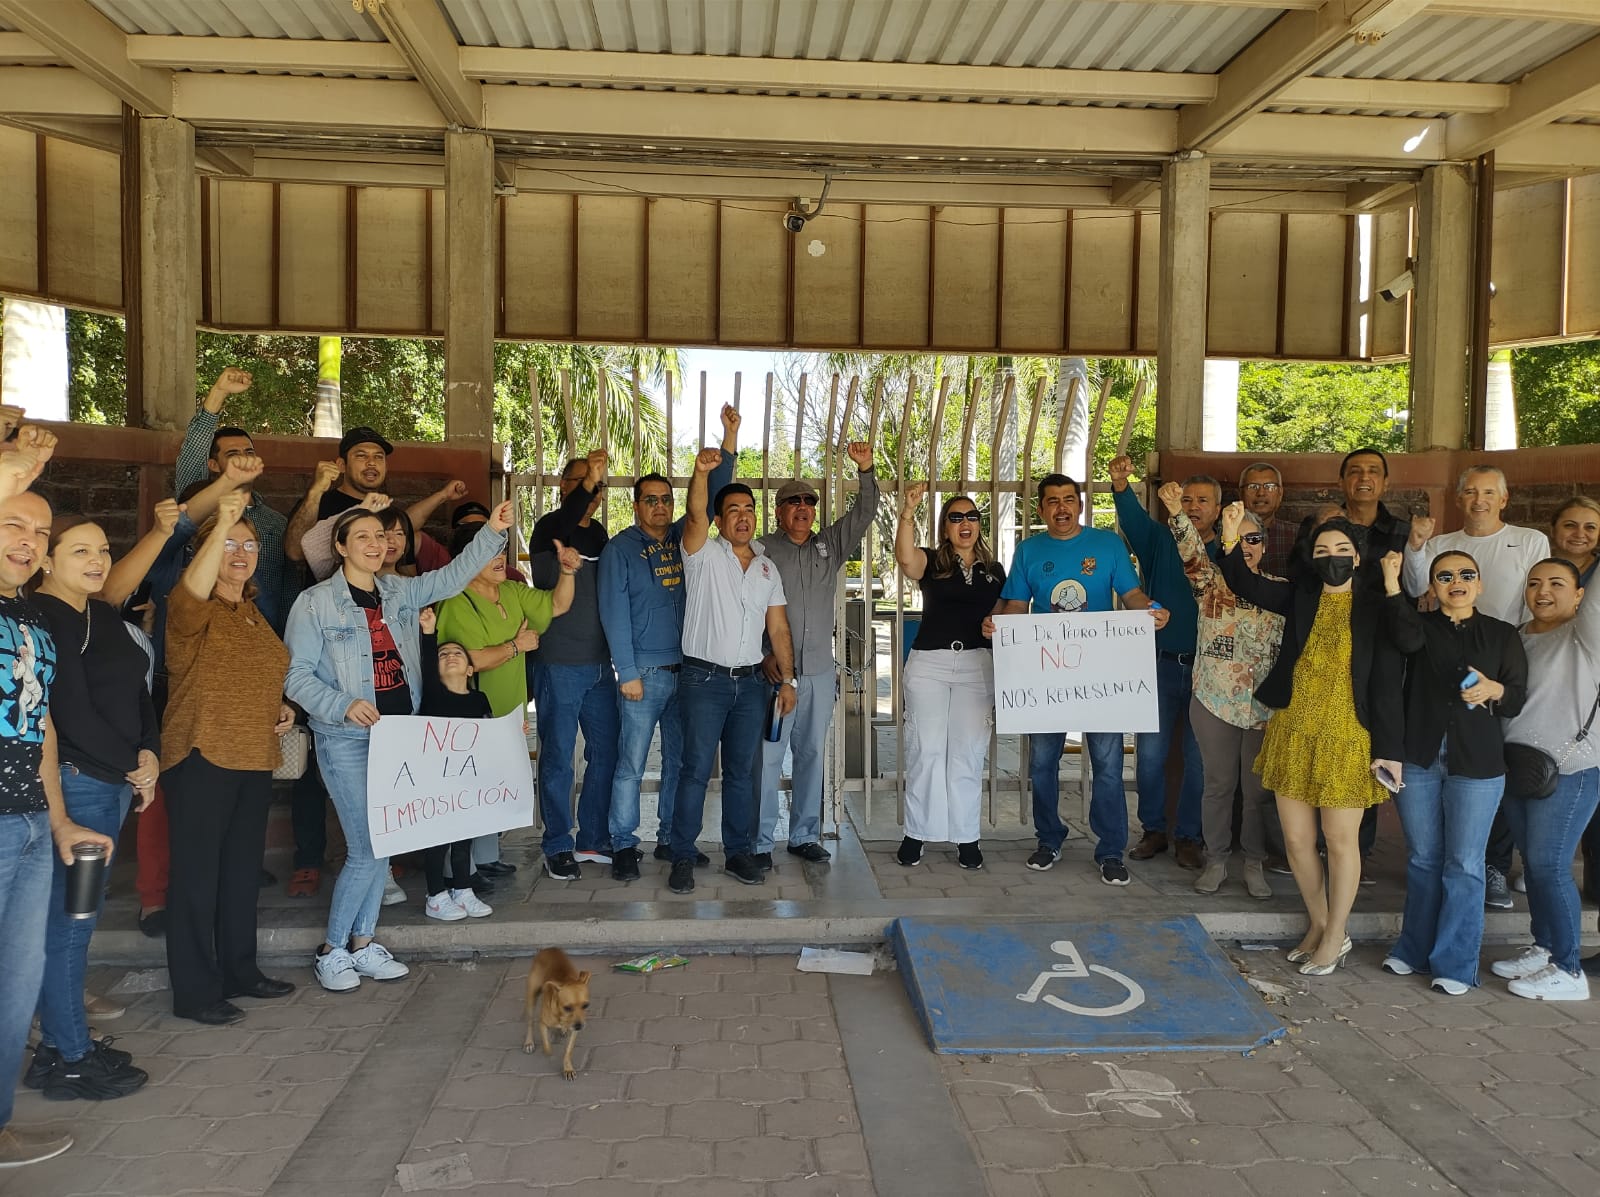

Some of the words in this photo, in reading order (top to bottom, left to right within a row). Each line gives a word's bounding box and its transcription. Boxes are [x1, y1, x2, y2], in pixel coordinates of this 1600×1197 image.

[1000, 625, 1022, 647] EL
[1041, 643, 1083, 672] NO
[1001, 687, 1037, 710] NOS
[1046, 679, 1152, 705] REPRESENTA
[422, 719, 480, 755] NO
[393, 761, 416, 790] A
[442, 754, 478, 779] LA
[372, 780, 520, 837] IMPOSICIÓN
